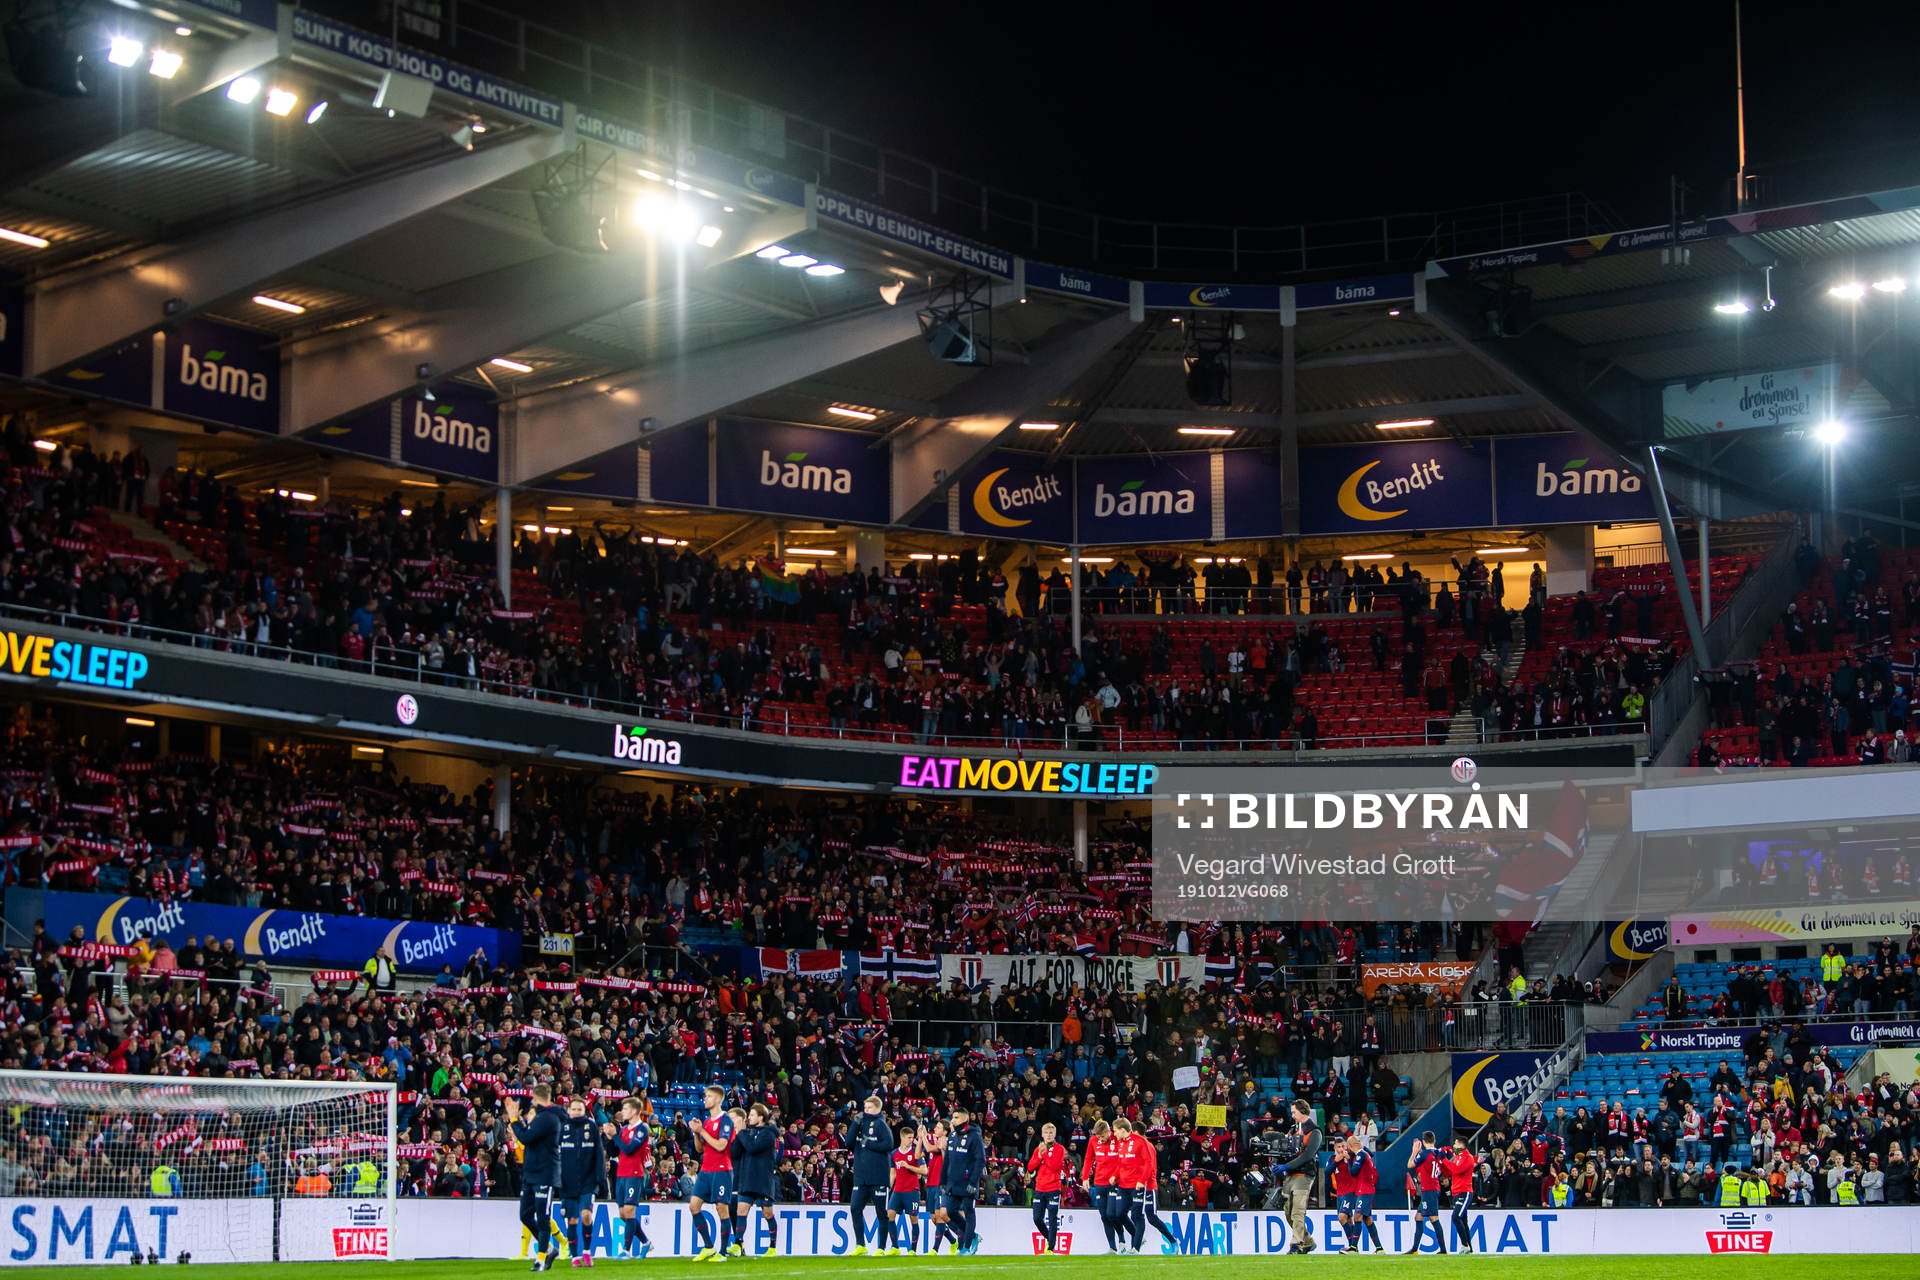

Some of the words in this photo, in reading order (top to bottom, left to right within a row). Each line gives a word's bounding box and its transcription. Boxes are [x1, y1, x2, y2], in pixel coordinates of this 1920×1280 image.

[294, 17, 344, 47] SUNT
[348, 37, 443, 81] KOSTHOLD
[447, 71, 473, 93] OG
[476, 80, 560, 121] AKTIVITET
[576, 113, 603, 138] GIR
[816, 194, 874, 227] OPPLEV
[877, 217, 1008, 273] BENDIT-EFFEKTEN
[1200, 287, 1231, 301] Bendit
[180, 344, 267, 401] bama
[1761, 374, 1774, 390] Gi
[1739, 386, 1799, 412] drømmen
[1752, 408, 1765, 420] en
[414, 401, 491, 454] bama
[760, 450, 851, 494] bama
[1366, 458, 1444, 505] Bendit
[998, 474, 1062, 510] Bendit
[1095, 483, 1195, 517] bama
[614, 724, 681, 765] bama
[121, 900, 185, 945] Bendit
[267, 912, 325, 954] Bendit
[1801, 912, 1816, 932] Gi
[1821, 910, 1876, 931] drømmen
[1880, 911, 1895, 925] en
[402, 923, 456, 963] Bendit
[543, 938, 558, 952] 231
[1008, 958, 1036, 988] ALT
[1049, 959, 1075, 993] FOR
[1084, 960, 1133, 992] NORGE
[1363, 966, 1425, 978] ARENA
[1428, 966, 1474, 977] KIOSK
[1661, 1034, 1696, 1047] Norsk
[1697, 1033, 1741, 1048] Tipping
[1850, 1025, 1864, 1042] Gi
[629, 1187, 635, 1197] 9
[719, 1185, 724, 1195] 3
[912, 1202, 919, 1210] 19
[10, 1204, 178, 1260] SMAT
[339, 1231, 388, 1252] TINE
[673, 1208, 932, 1255] IDETTSMAT
[1161, 1212, 1238, 1255] SMART
[1712, 1234, 1765, 1250] TINE
